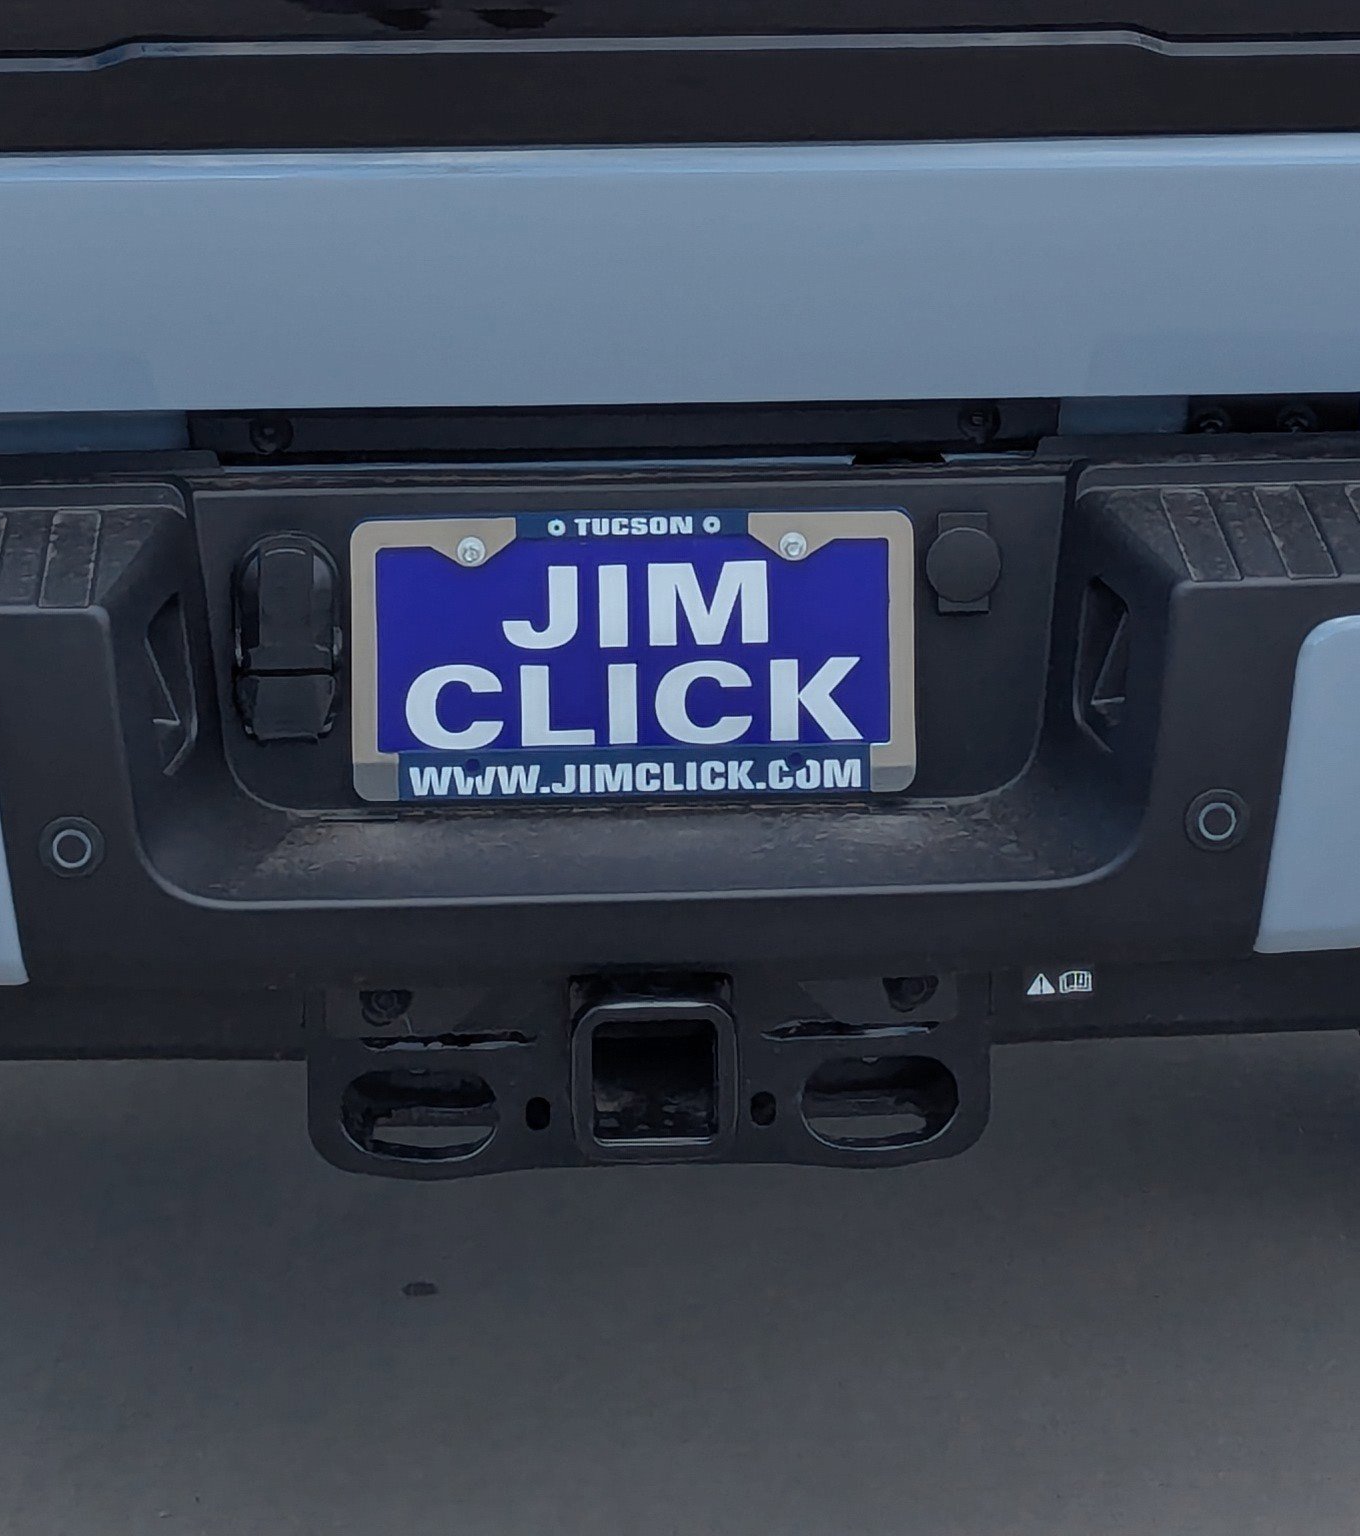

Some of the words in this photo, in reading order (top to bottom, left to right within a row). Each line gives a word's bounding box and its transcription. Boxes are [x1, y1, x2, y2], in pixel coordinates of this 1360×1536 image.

[575, 517, 694, 536] TUCSON
[501, 560, 769, 649] JIM
[404, 656, 863, 750] CLICK
[409, 758, 862, 796] WWW.JIMCLICK.COM
